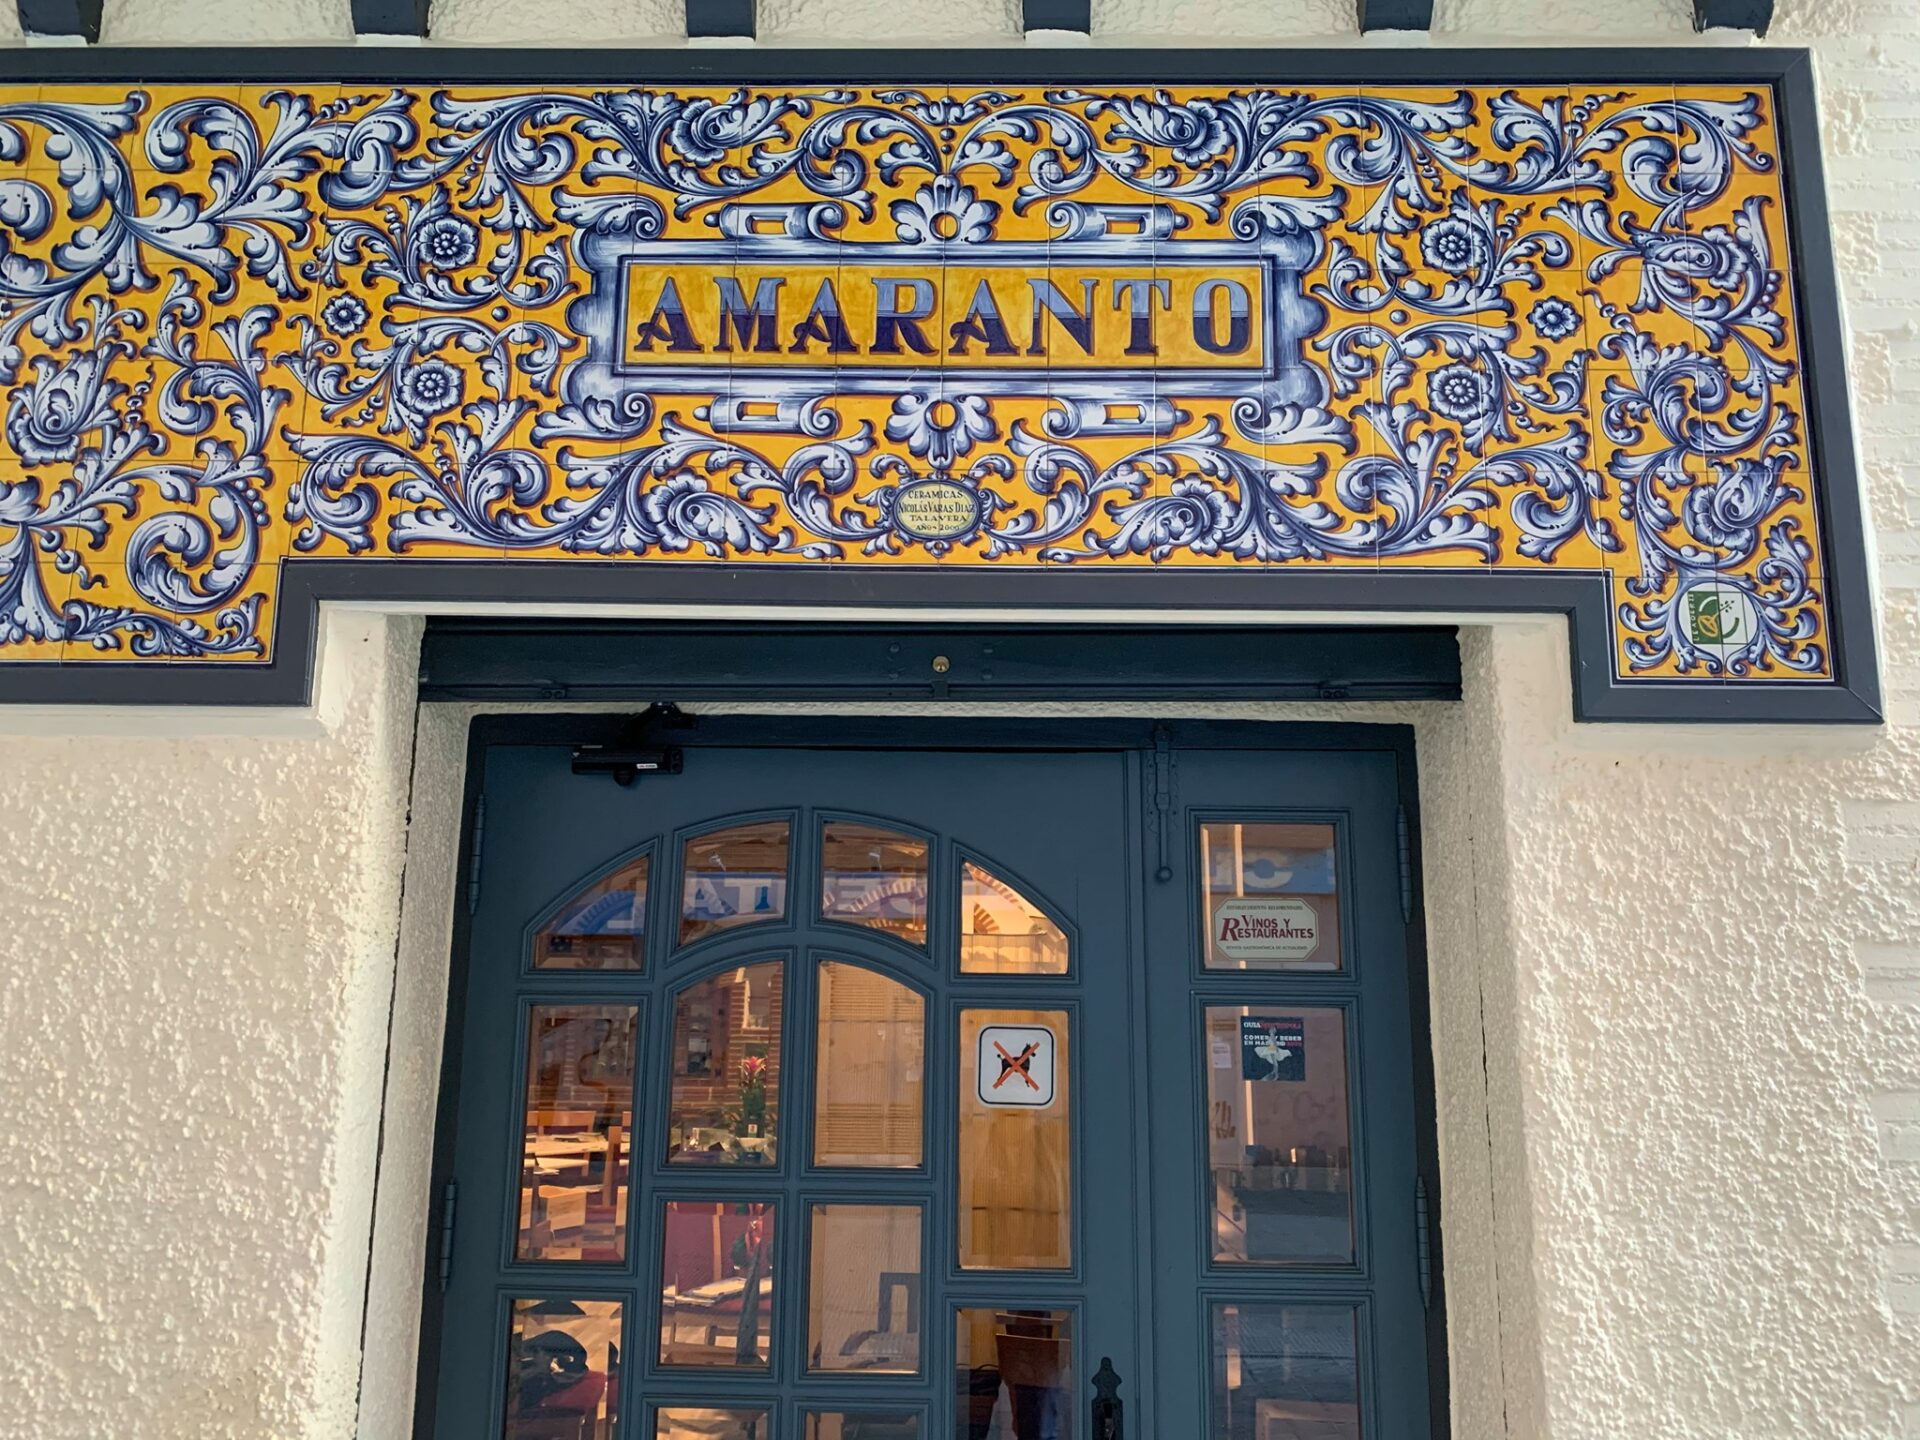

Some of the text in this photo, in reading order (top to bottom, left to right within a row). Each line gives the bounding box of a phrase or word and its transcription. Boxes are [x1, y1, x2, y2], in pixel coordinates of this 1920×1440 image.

[633, 277, 1252, 357] AMARANTO
[908, 490, 964, 499] CERAMICAS
[928, 501, 954, 513] VARAS
[910, 514, 967, 522] TALAVERA
[1241, 915, 1291, 929] VINOS Y
[1220, 918, 1314, 941] RESTAURANTES
